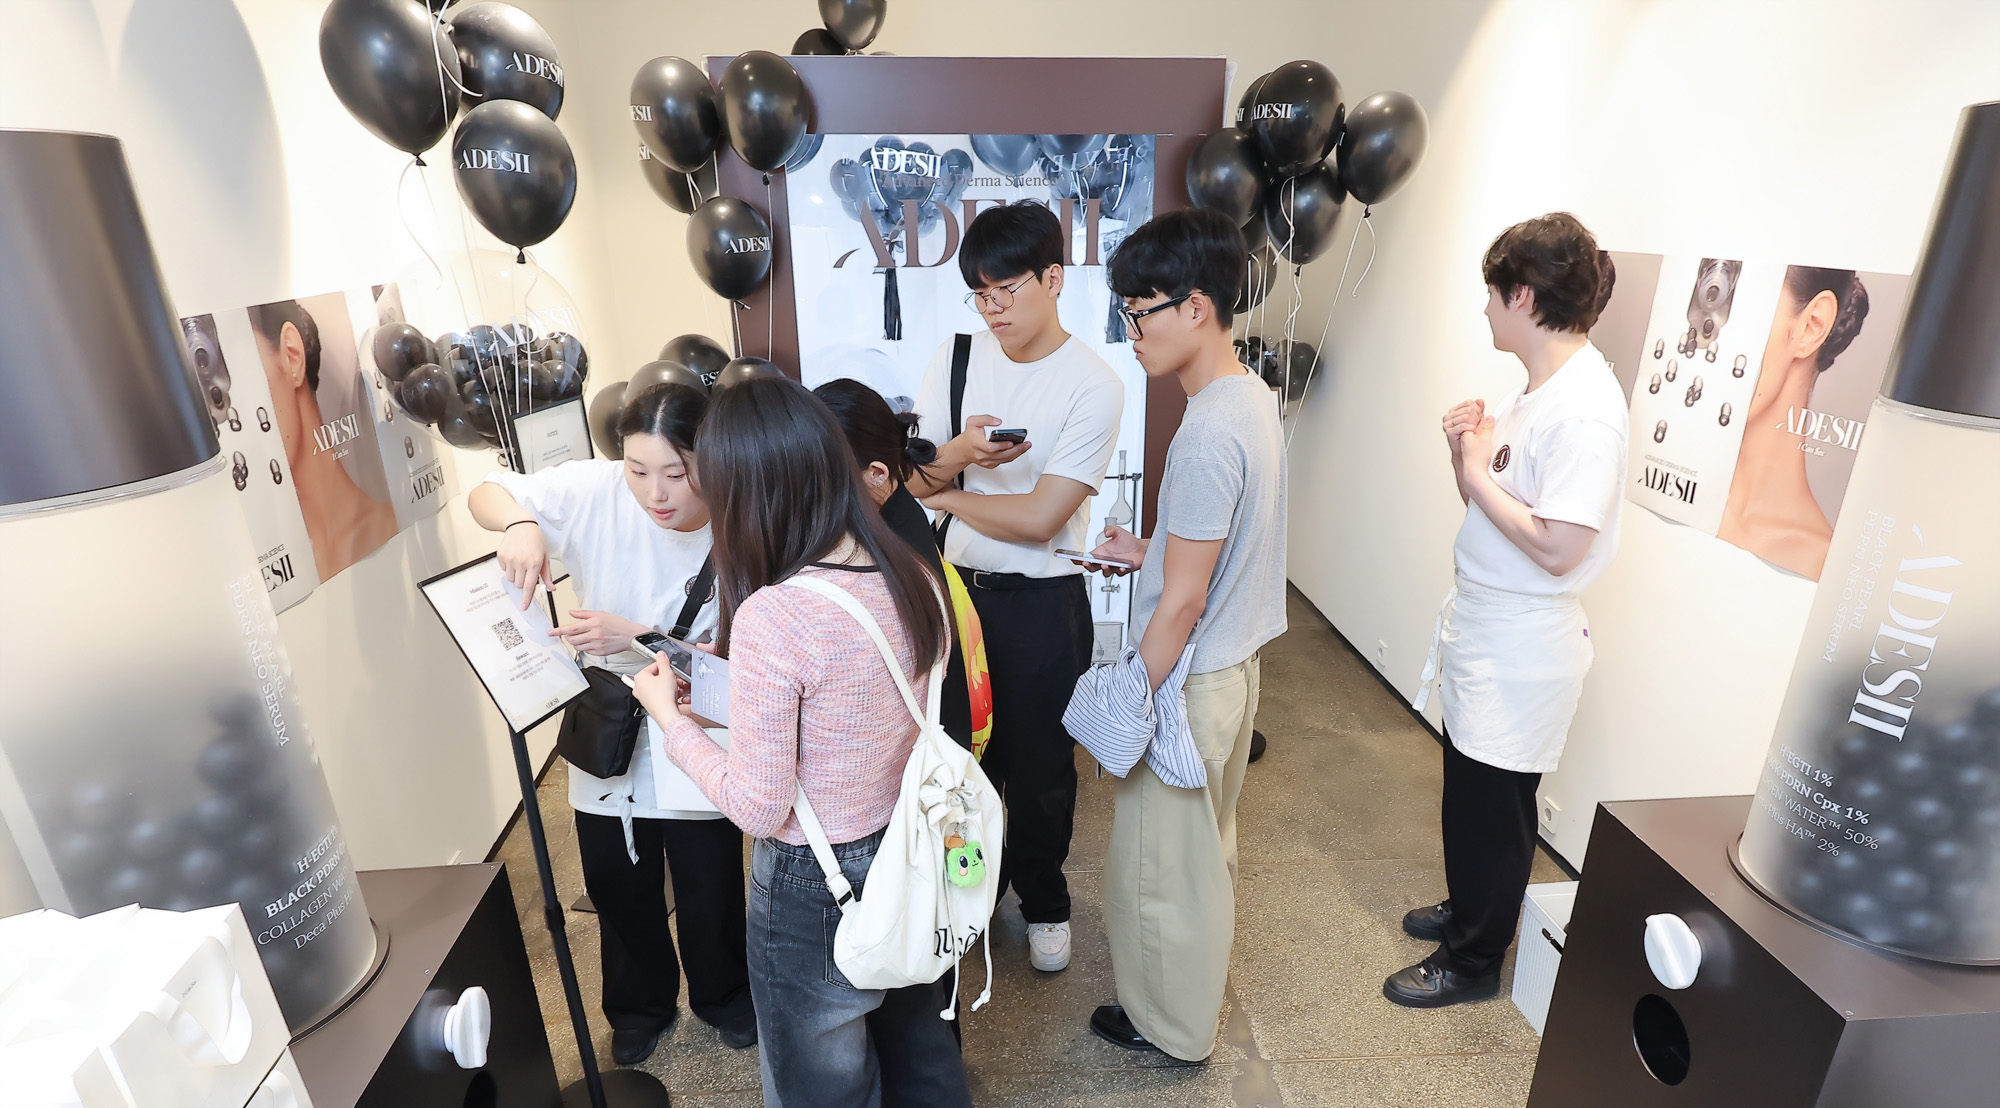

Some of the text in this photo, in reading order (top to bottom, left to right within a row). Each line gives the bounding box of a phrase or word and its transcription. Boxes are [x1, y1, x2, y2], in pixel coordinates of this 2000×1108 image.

[459, 148, 531, 174] ADESII
[861, 145, 942, 179] ADESII
[725, 236, 770, 254] ADESII
[312, 413, 360, 456] ADESII
[1775, 404, 1866, 452] ADESII
[411, 465, 445, 503] ADESII
[1637, 465, 1698, 504] ADESII
[261, 553, 295, 593] ESII
[1823, 509, 1879, 664] PDRN NEO SERUM
[1848, 514, 1897, 632] BLACK PEARL
[1848, 522, 1965, 743] ADESII
[229, 581, 291, 748] PDRN NEO SERUM
[264, 640, 286, 699] PEARL
[1780, 769, 1812, 798] PDRN
[1813, 792, 1841, 814] Cpx
[1844, 807, 1870, 825] 1%
[1812, 769, 1834, 788] 1%
[1767, 803, 1784, 825] Plus
[1817, 838, 1840, 857] 2%
[1844, 828, 1879, 850] 50%
[264, 848, 341, 919] BLACK PDRN
[257, 887, 332, 945] COLLAGEN
[294, 922, 327, 950] Deca
[326, 901, 345, 926] Plus
